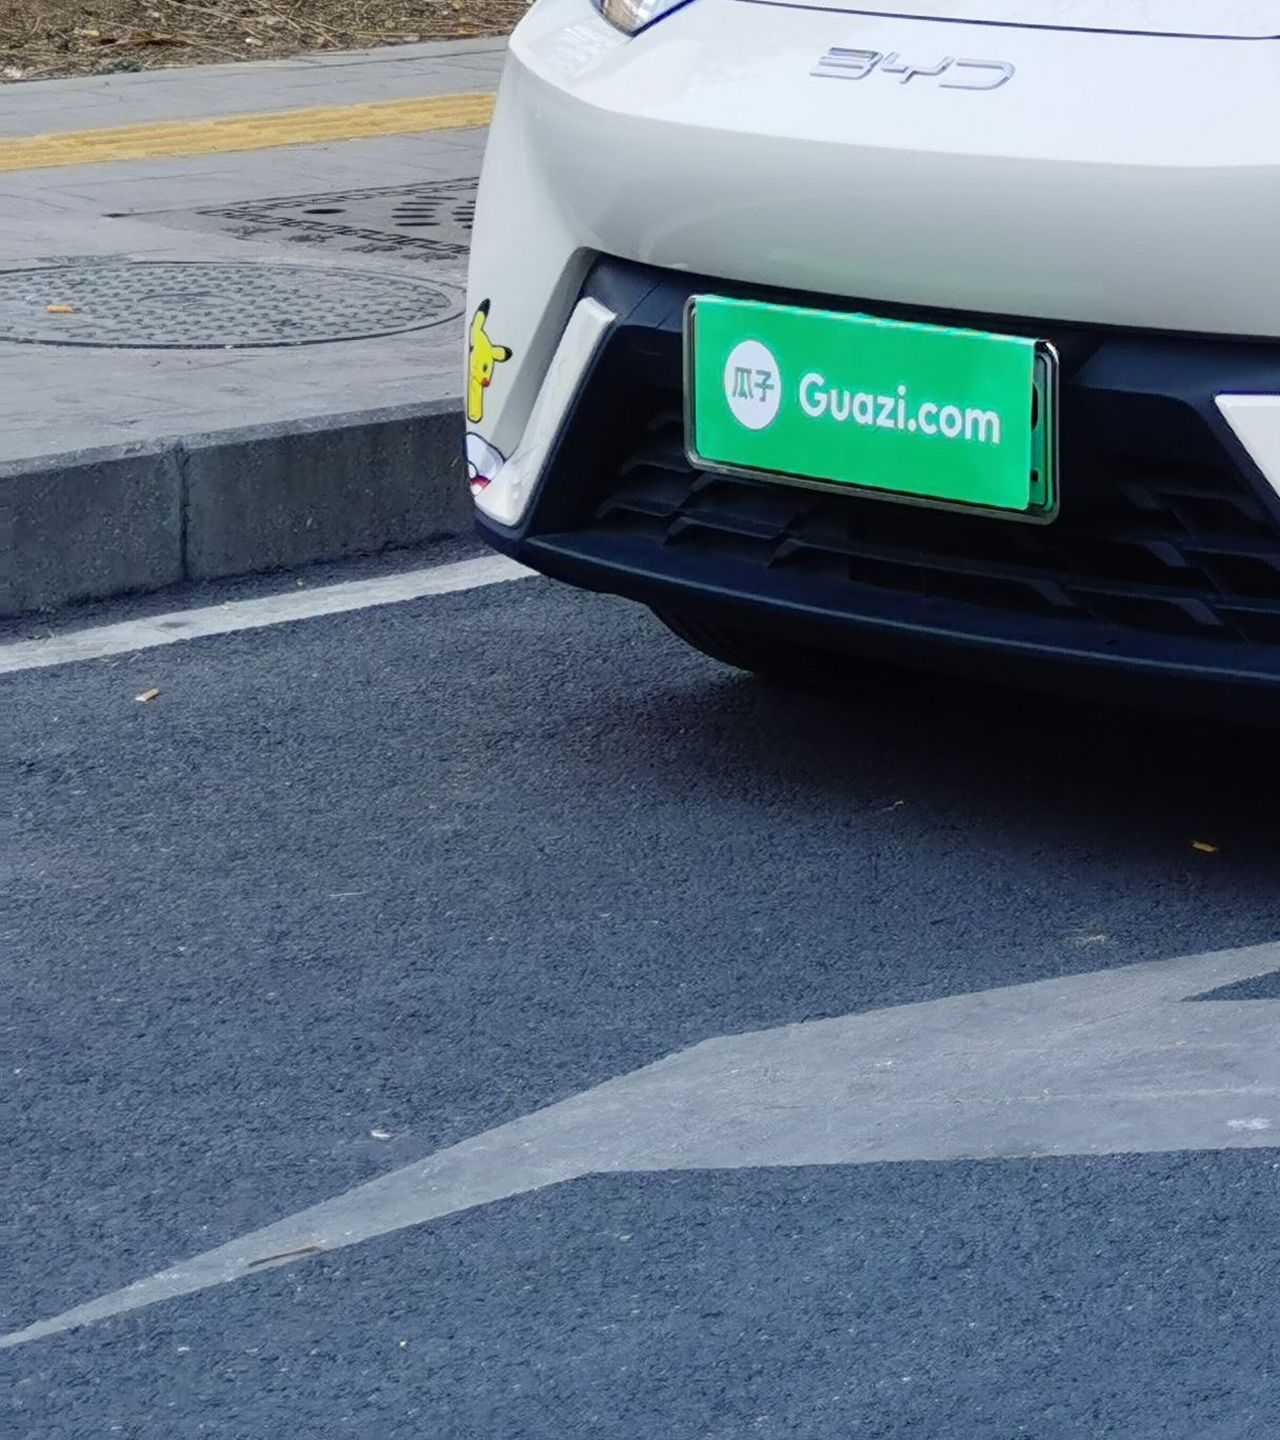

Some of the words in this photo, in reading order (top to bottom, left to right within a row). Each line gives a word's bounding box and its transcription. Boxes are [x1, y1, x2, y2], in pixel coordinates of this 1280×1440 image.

[808, 46, 1017, 91] BYD
[732, 366, 775, 403] 瓜子
[799, 372, 1001, 445] Guazi.com
